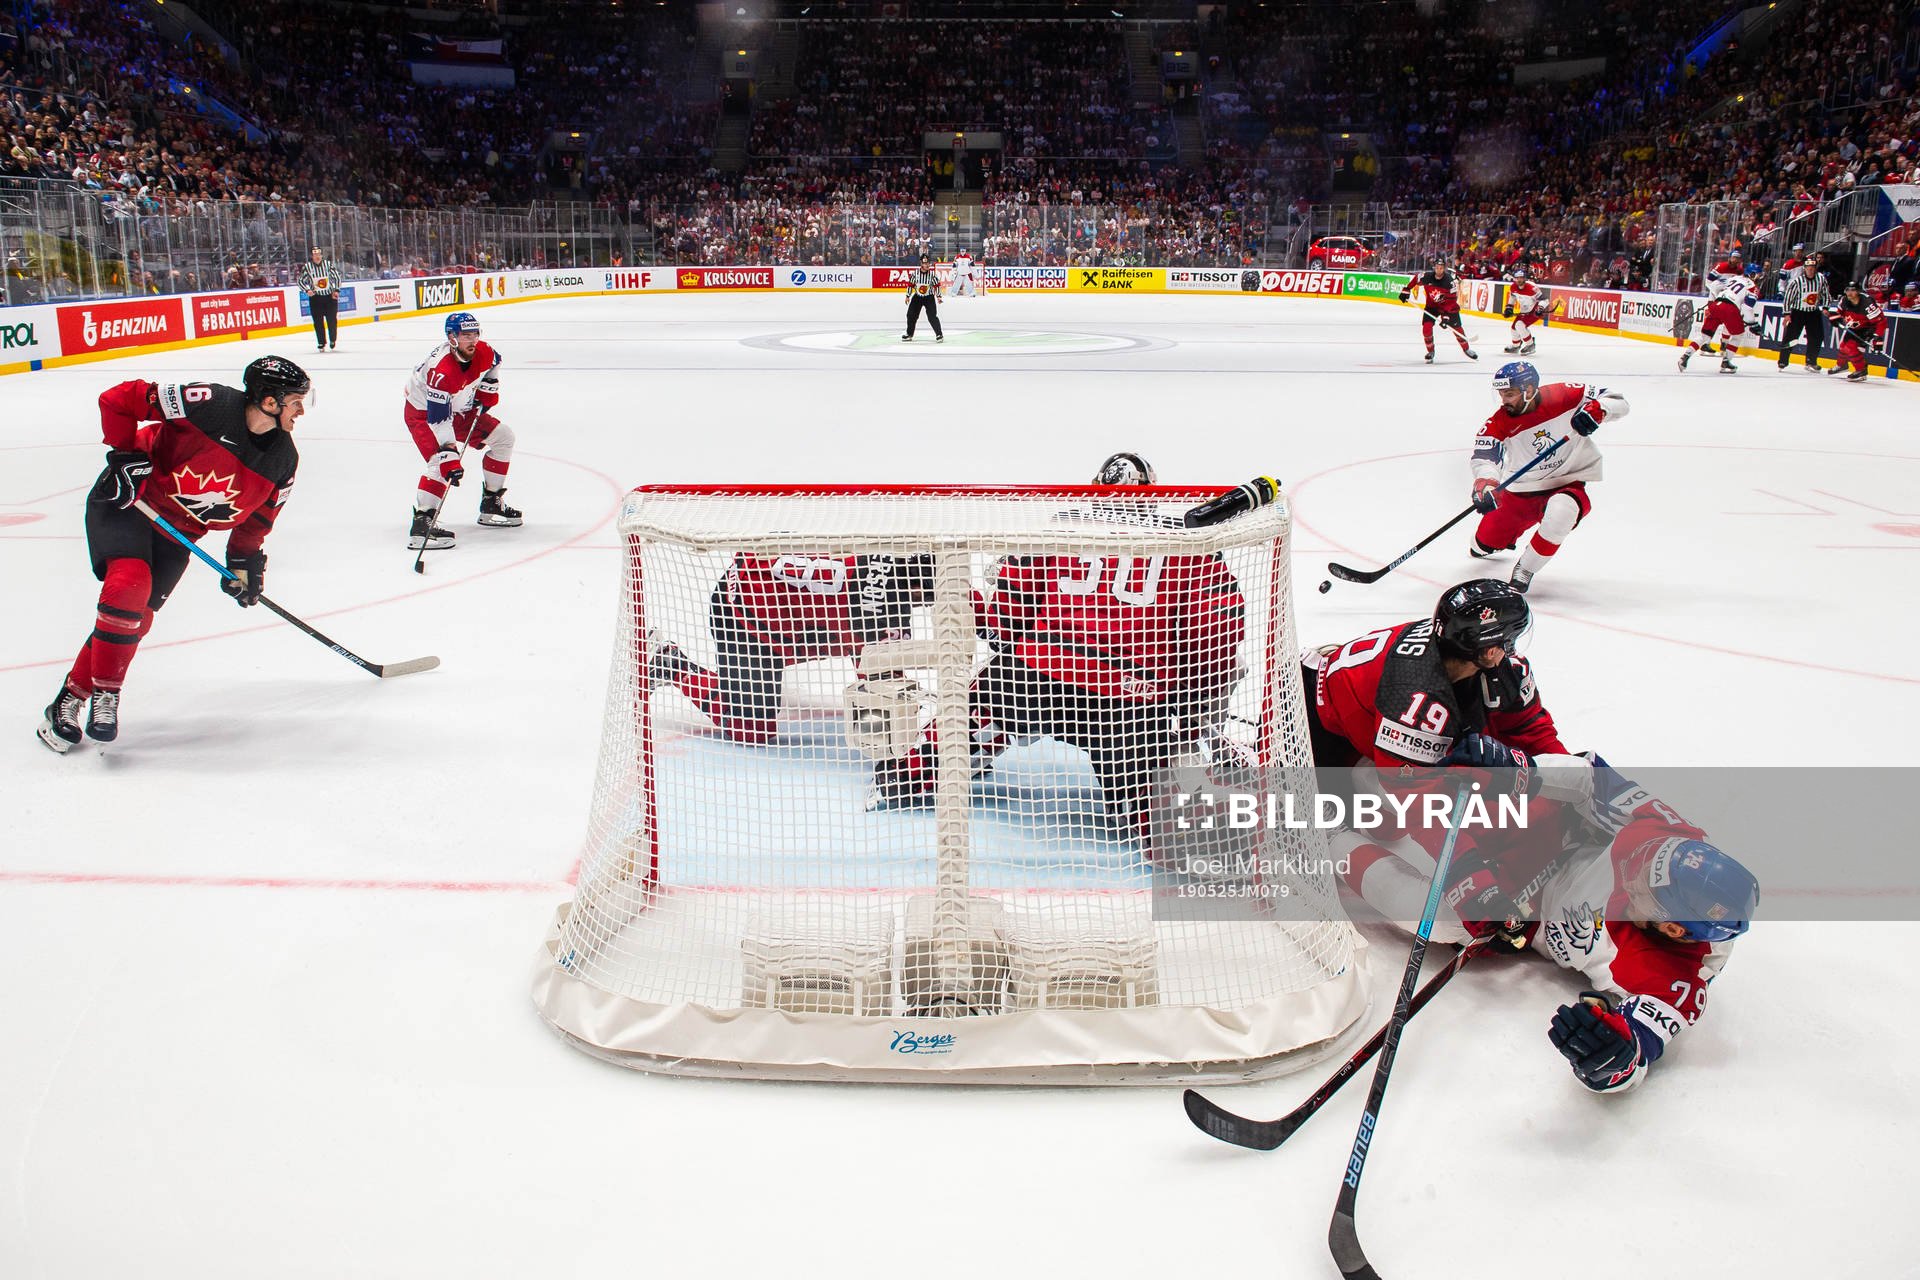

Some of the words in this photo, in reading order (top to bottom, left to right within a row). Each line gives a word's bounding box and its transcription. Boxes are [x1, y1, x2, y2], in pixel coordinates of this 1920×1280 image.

[554, 276, 584, 287] ŠKODA
[614, 272, 651, 289] IIHF
[703, 269, 770, 287] KRUŠOVICE
[811, 273, 853, 283] ZURICH
[1006, 269, 1033, 279] LIQUI
[1038, 269, 1065, 279] LIQUI
[1102, 269, 1153, 278] Raiffeisen
[1190, 272, 1239, 282] TISSOT
[524, 279, 543, 289] ŠKODA
[1006, 279, 1033, 288] MOLY
[1038, 279, 1065, 288] MOLY
[1102, 280, 1133, 288] BANK
[1262, 272, 1344, 294] ФОНБЕТ
[1358, 279, 1383, 291] ŠKODA
[374, 291, 401, 305] STRABAG
[422, 279, 457, 308] isostar
[1567, 295, 1618, 323] KRUŠOVICE
[1636, 302, 1673, 319] TISSOT
[101, 315, 168, 339] BENZINA
[202, 307, 281, 332] #BRATISLAVA
[428, 370, 446, 388] 17
[167, 383, 181, 416] ISSOT
[1399, 692, 1449, 736] 19
[1401, 732, 1448, 753] TISSOT
[1670, 979, 1708, 1024] 79
[890, 1030, 957, 1054] Berger
[1343, 1110, 1377, 1189] BAUER
